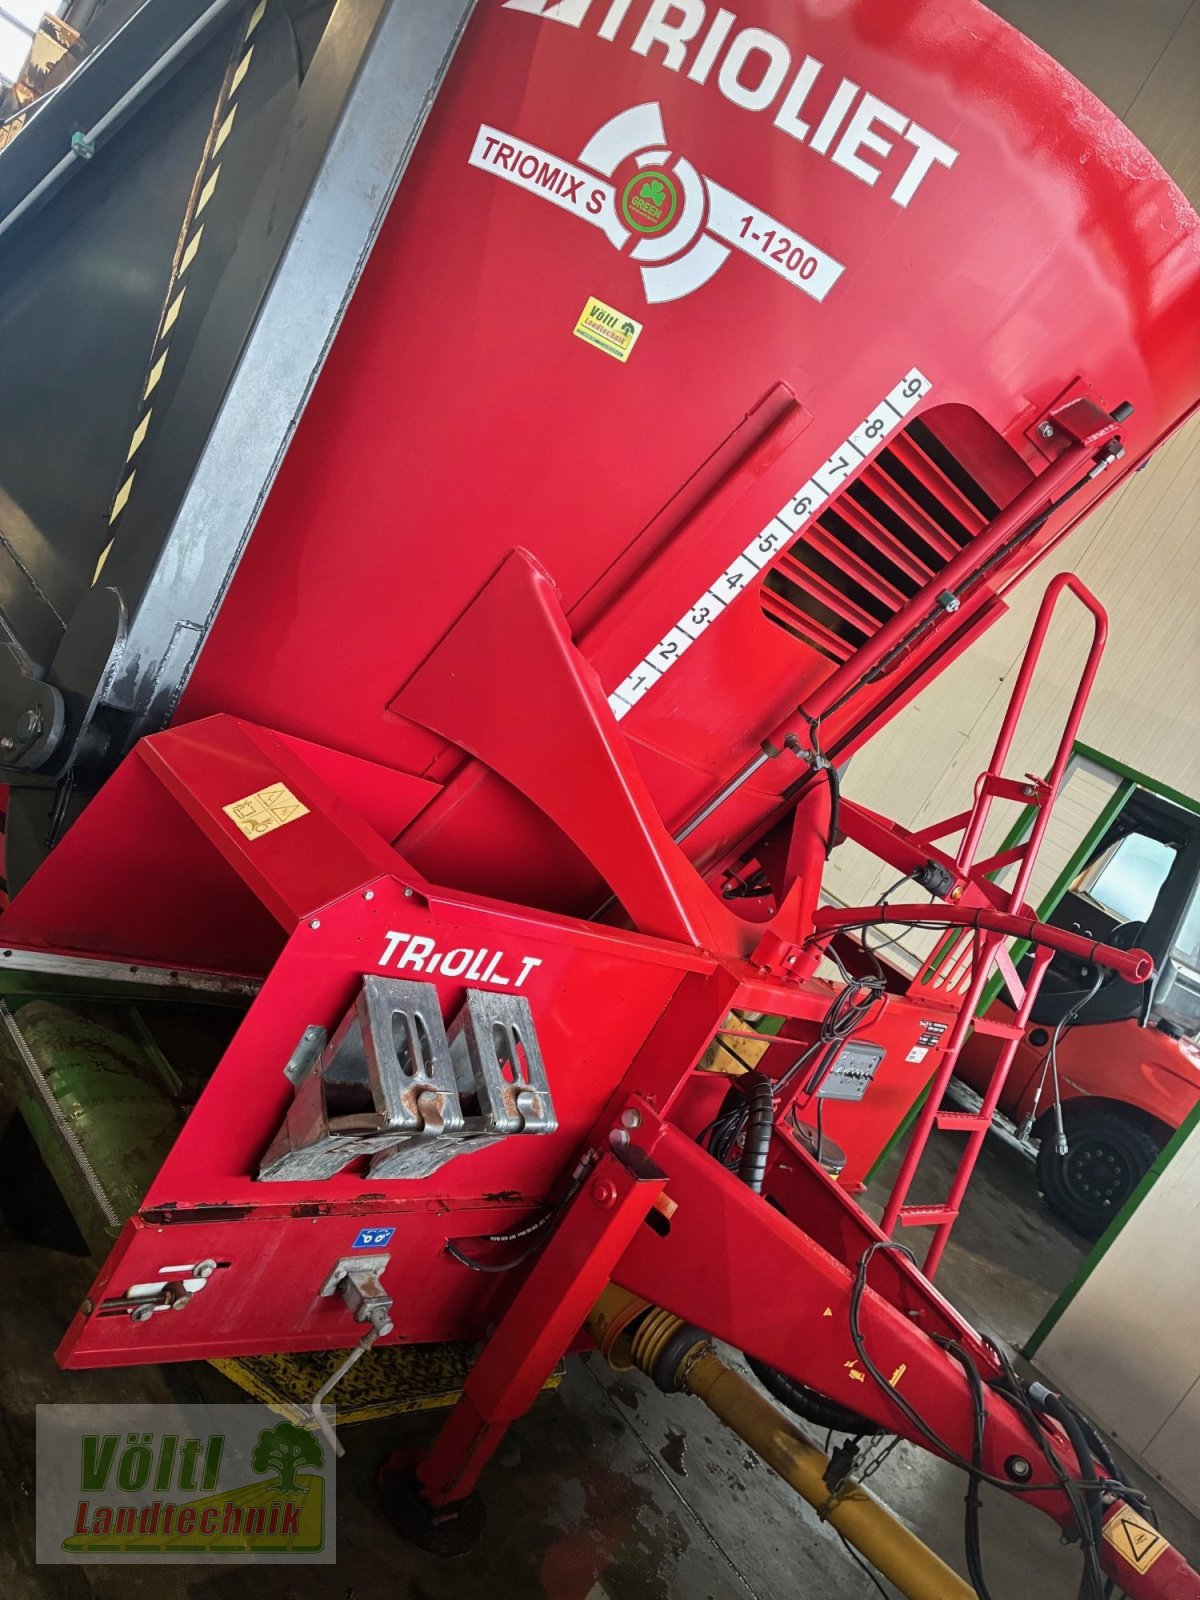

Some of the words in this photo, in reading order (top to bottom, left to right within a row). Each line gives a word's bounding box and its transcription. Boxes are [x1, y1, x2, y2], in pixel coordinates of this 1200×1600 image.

[481, 136, 585, 204] TRIOMIX
[585, 189, 606, 215] S
[631, 196, 662, 219] GREEN
[739, 215, 818, 280] 1-1200
[589, 304, 619, 329] Völtl
[902, 378, 922, 398] 9
[865, 419, 884, 439] 8
[828, 456, 849, 475] 7
[793, 497, 812, 516] 6
[758, 533, 778, 553] 5
[726, 573, 743, 589] 4
[692, 607, 710, 625] 3
[659, 642, 678, 660] 2
[632, 676, 646, 691] 1
